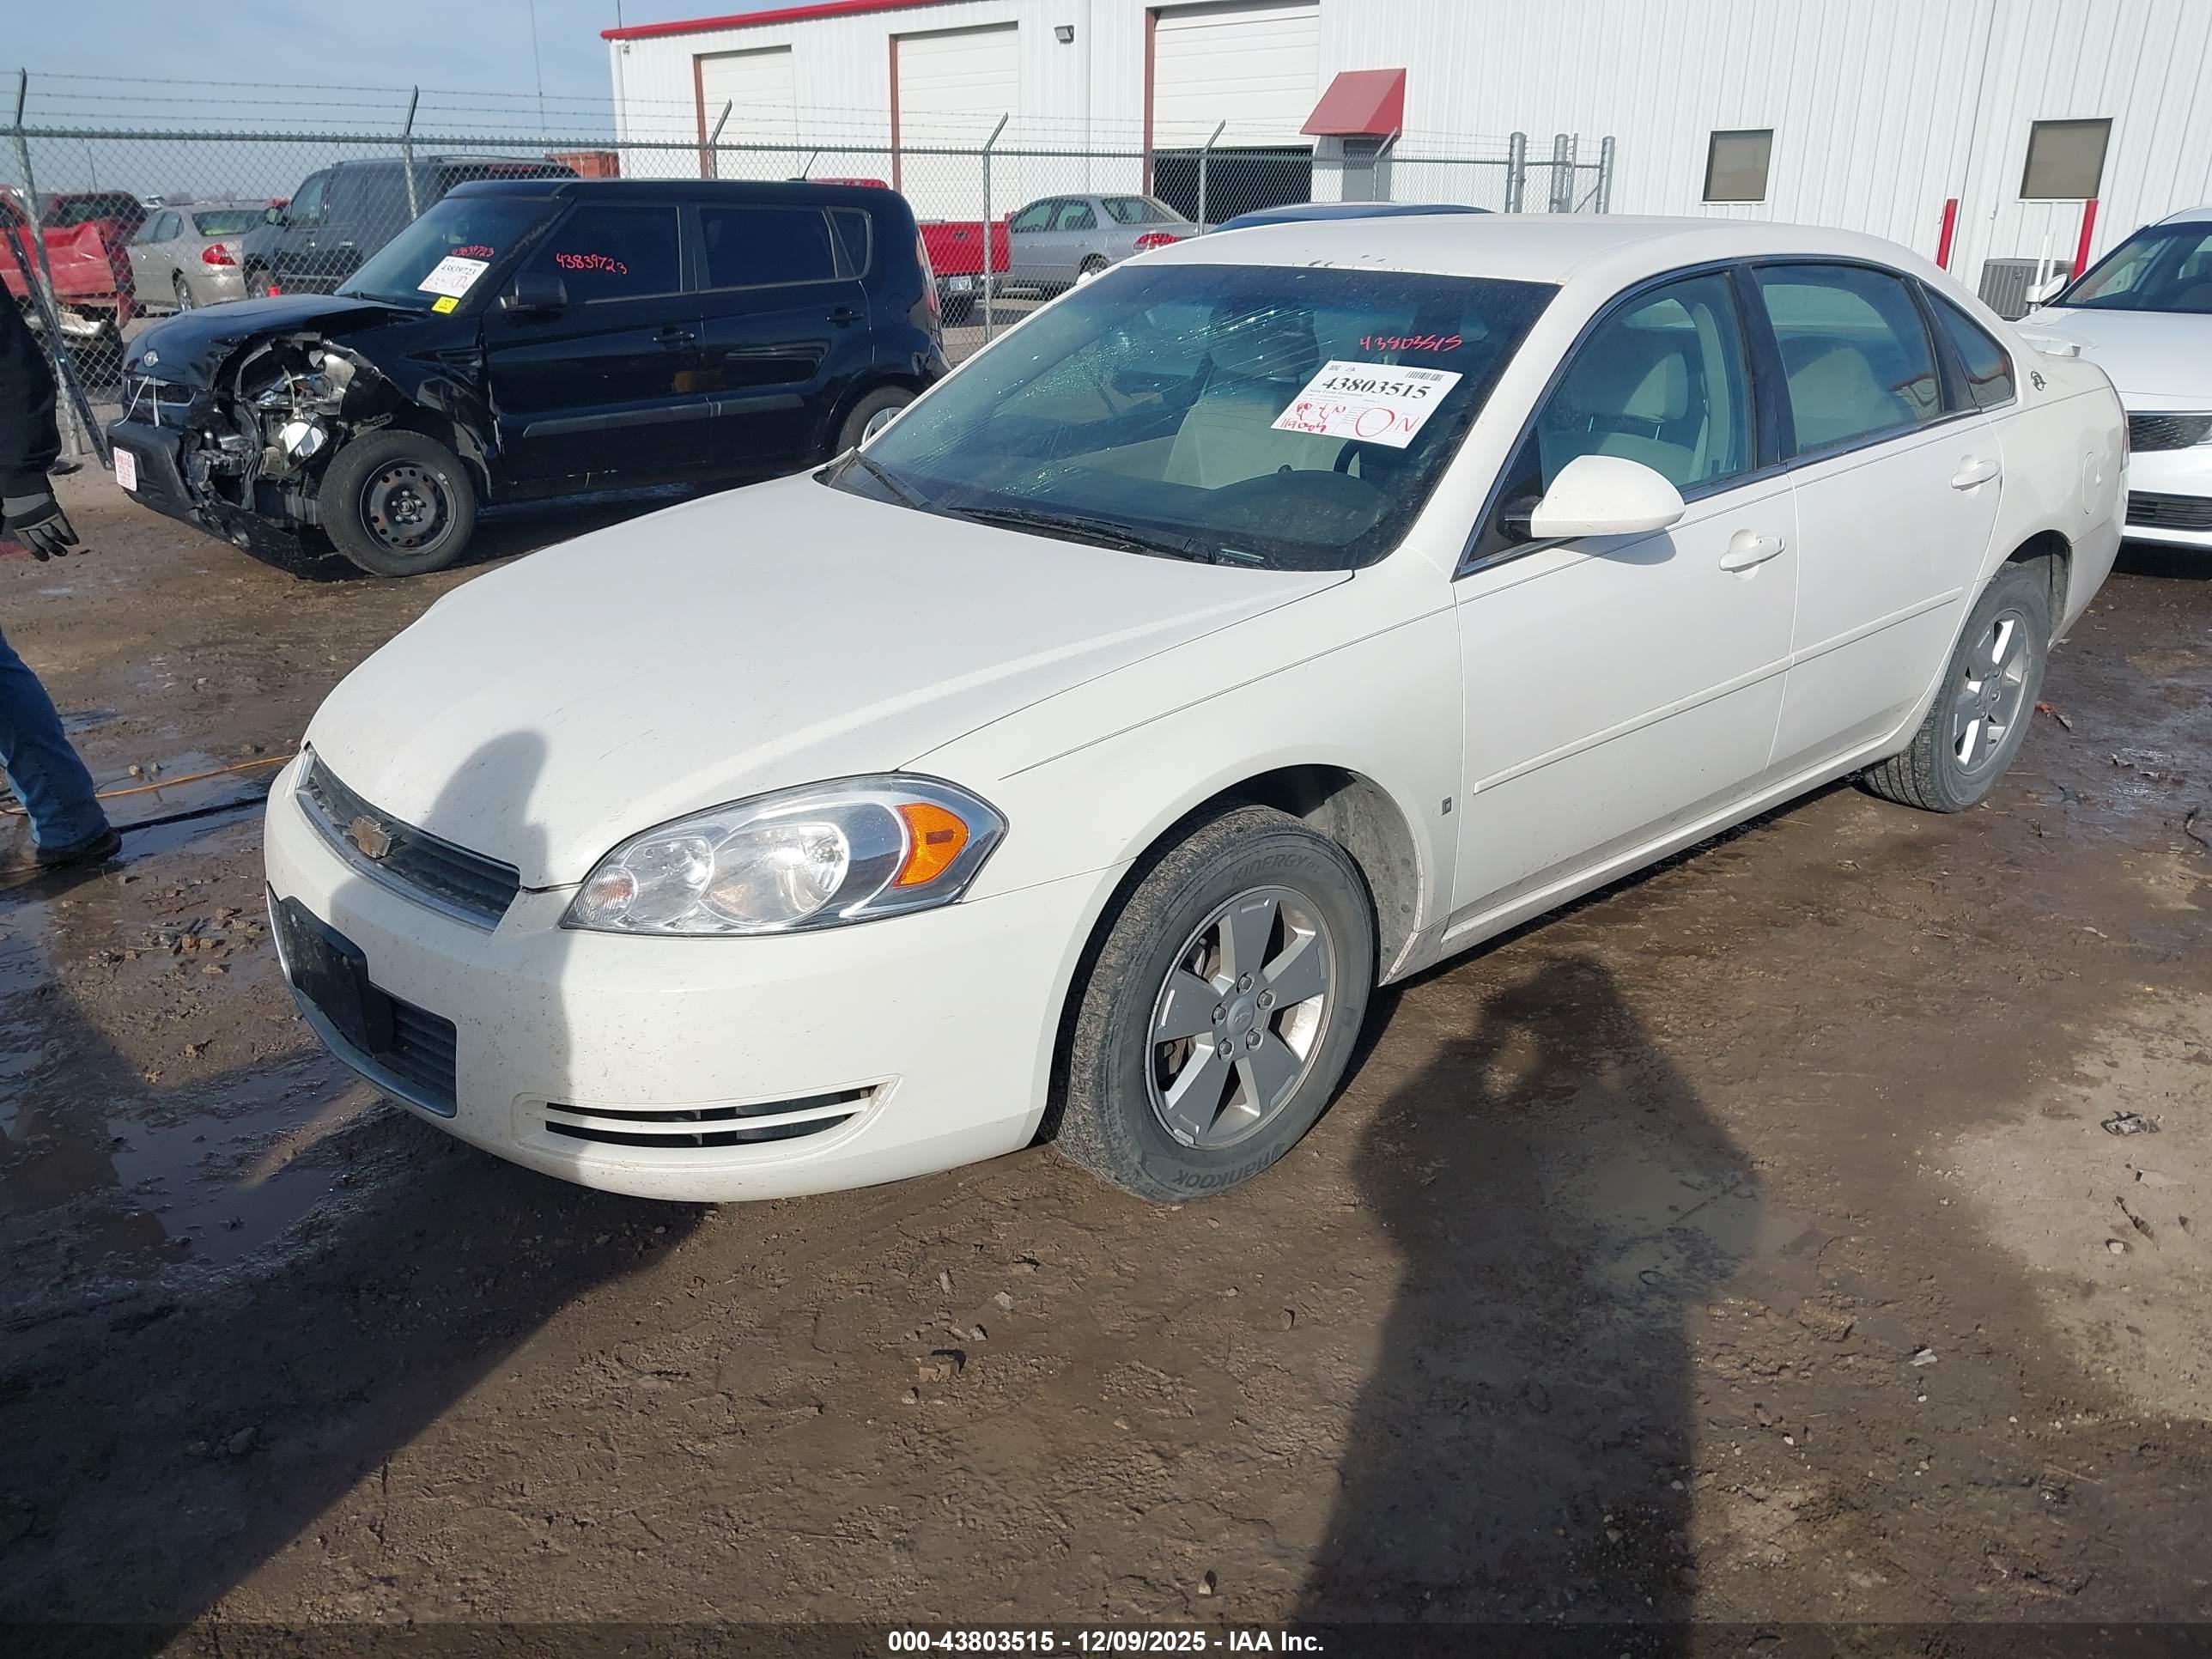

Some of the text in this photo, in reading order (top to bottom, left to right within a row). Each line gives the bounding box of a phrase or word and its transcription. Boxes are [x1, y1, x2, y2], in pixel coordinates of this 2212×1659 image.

[556, 252, 628, 275] 43839723
[1359, 334, 1462, 352] 43803515
[1322, 376, 1431, 399] 43803515
